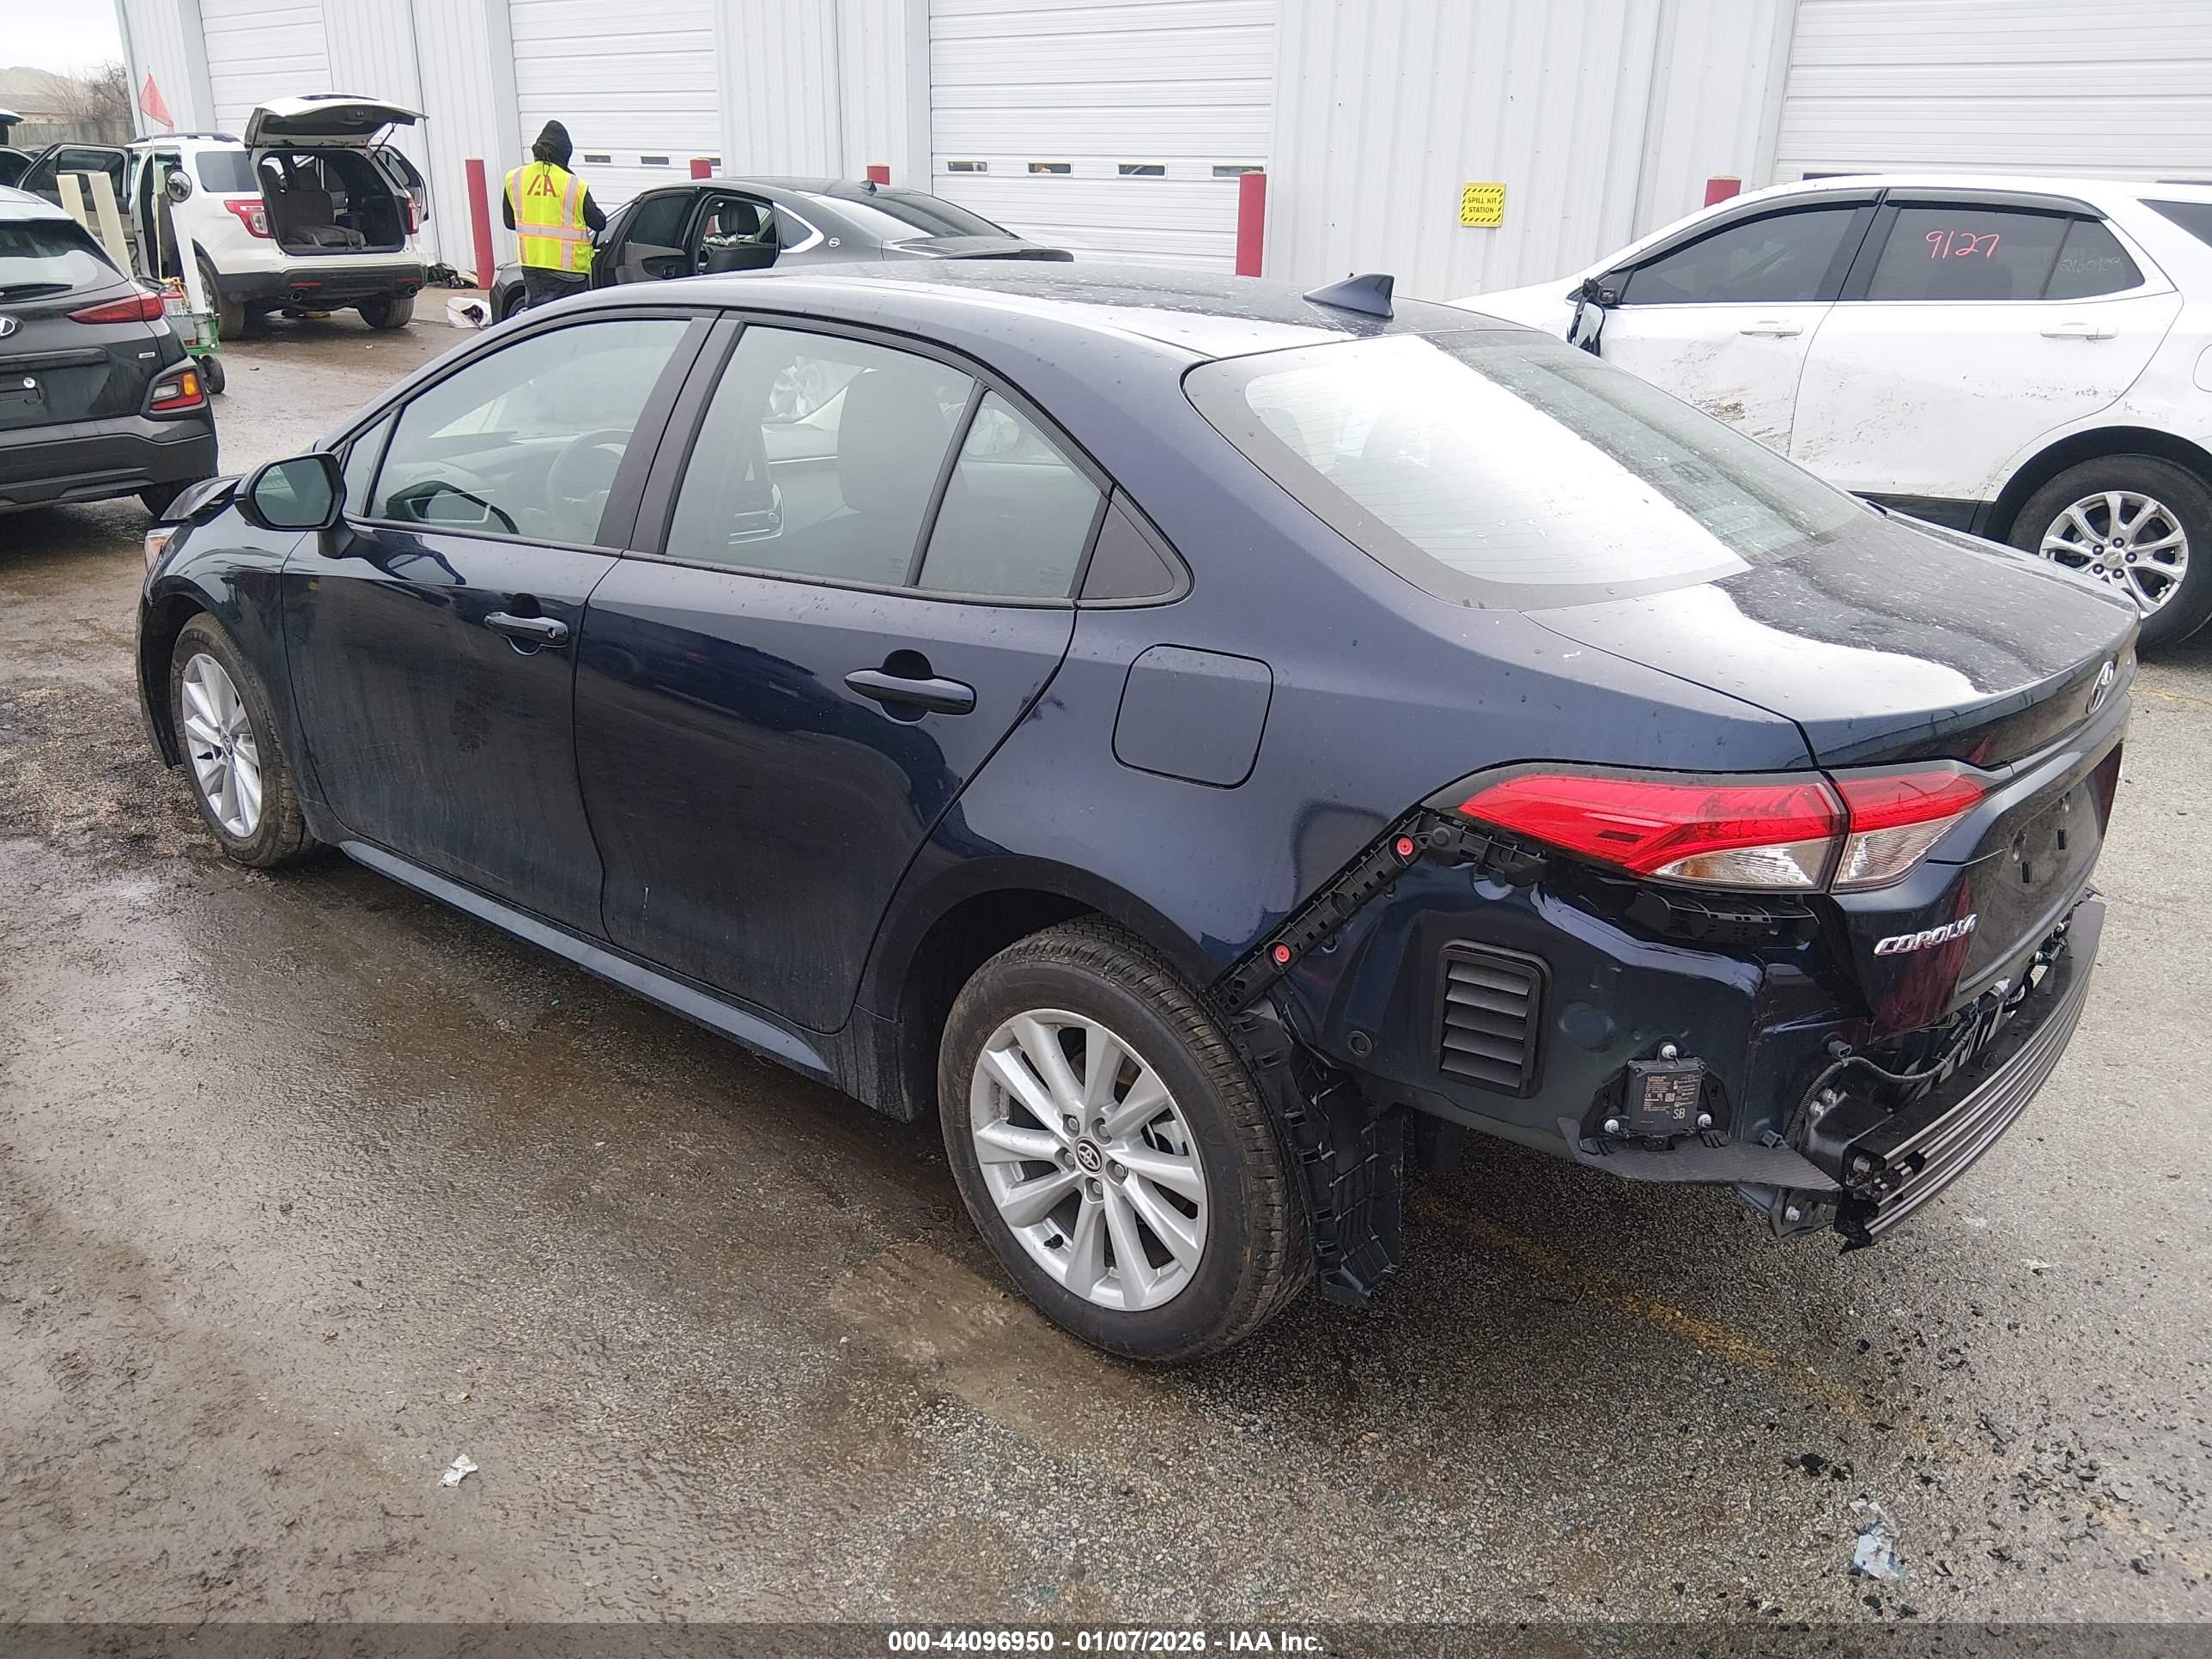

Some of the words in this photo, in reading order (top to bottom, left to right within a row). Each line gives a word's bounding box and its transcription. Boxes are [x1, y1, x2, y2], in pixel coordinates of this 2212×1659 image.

[1925, 230, 2000, 259] 9127
[1873, 914, 1978, 956] COROLLA
[1673, 1107, 1686, 1120] SB
